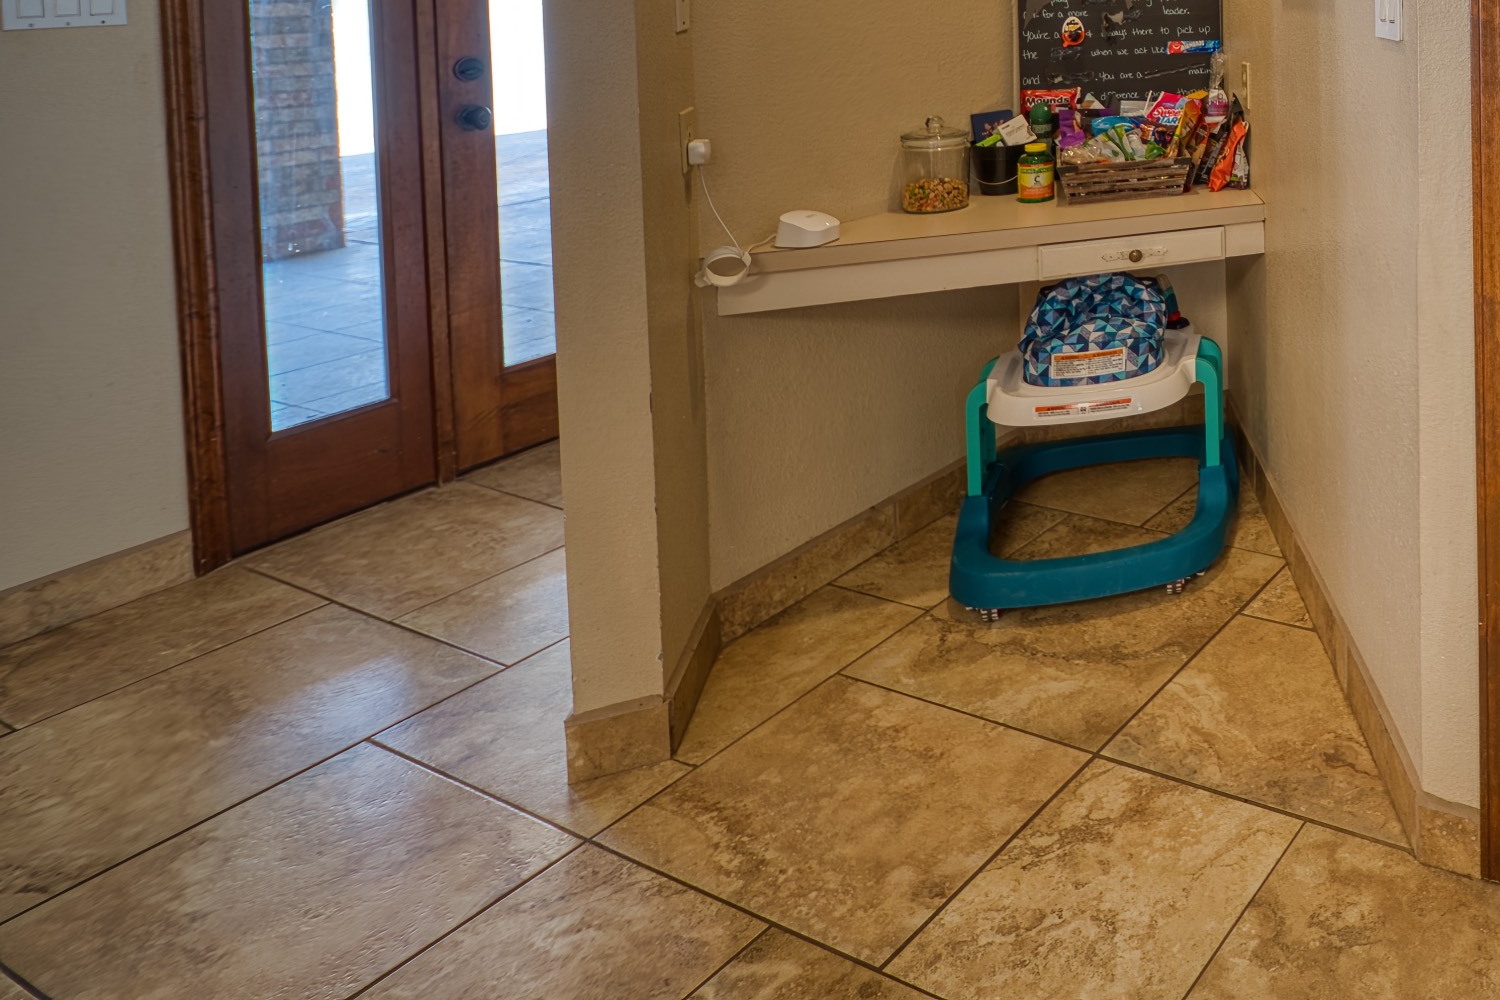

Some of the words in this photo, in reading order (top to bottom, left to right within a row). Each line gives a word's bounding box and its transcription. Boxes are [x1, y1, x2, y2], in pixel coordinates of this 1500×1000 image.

[1162, 5, 1190, 15] leader.
[1132, 27, 1154, 36] there
[1160, 26, 1170, 35] to
[1176, 25, 1194, 37] pick
[1198, 25, 1211, 35] up
[1022, 49, 1039, 60] the
[1091, 48, 1113, 57] when
[1117, 48, 1129, 56] we
[1134, 46, 1148, 54] act
[1151, 46, 1165, 54] like
[1022, 74, 1041, 86] and
[1025, 96, 1070, 107] Mounds
